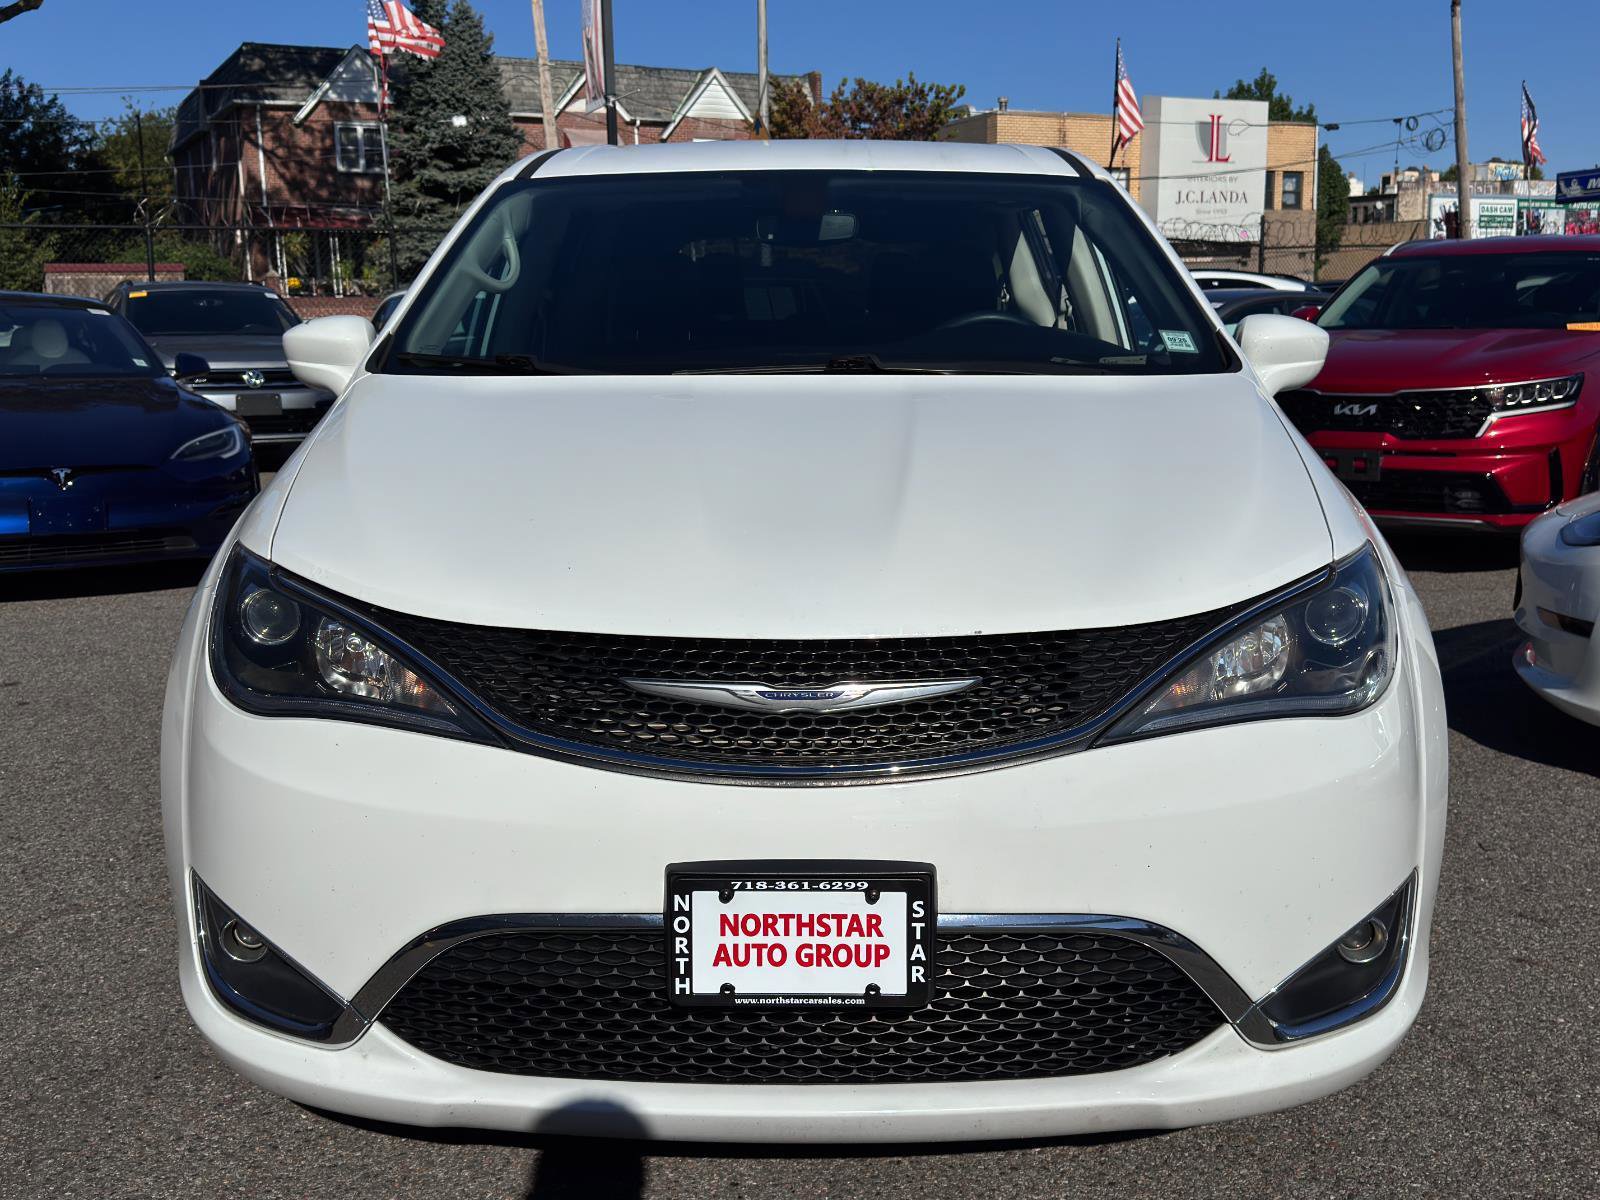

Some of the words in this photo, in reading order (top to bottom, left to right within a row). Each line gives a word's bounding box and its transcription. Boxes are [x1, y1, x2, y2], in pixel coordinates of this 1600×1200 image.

[1481, 205, 1498, 213] DASH
[1499, 205, 1513, 213] CAM
[731, 881, 869, 890] 718-361-6299
[719, 913, 885, 938] NORTHSTAR
[673, 894, 691, 995] NORTH
[910, 900, 926, 983] STAR
[712, 943, 788, 967] AUTO
[795, 943, 891, 968] GROUP
[734, 997, 866, 1006] www.northstarcarsales.com
